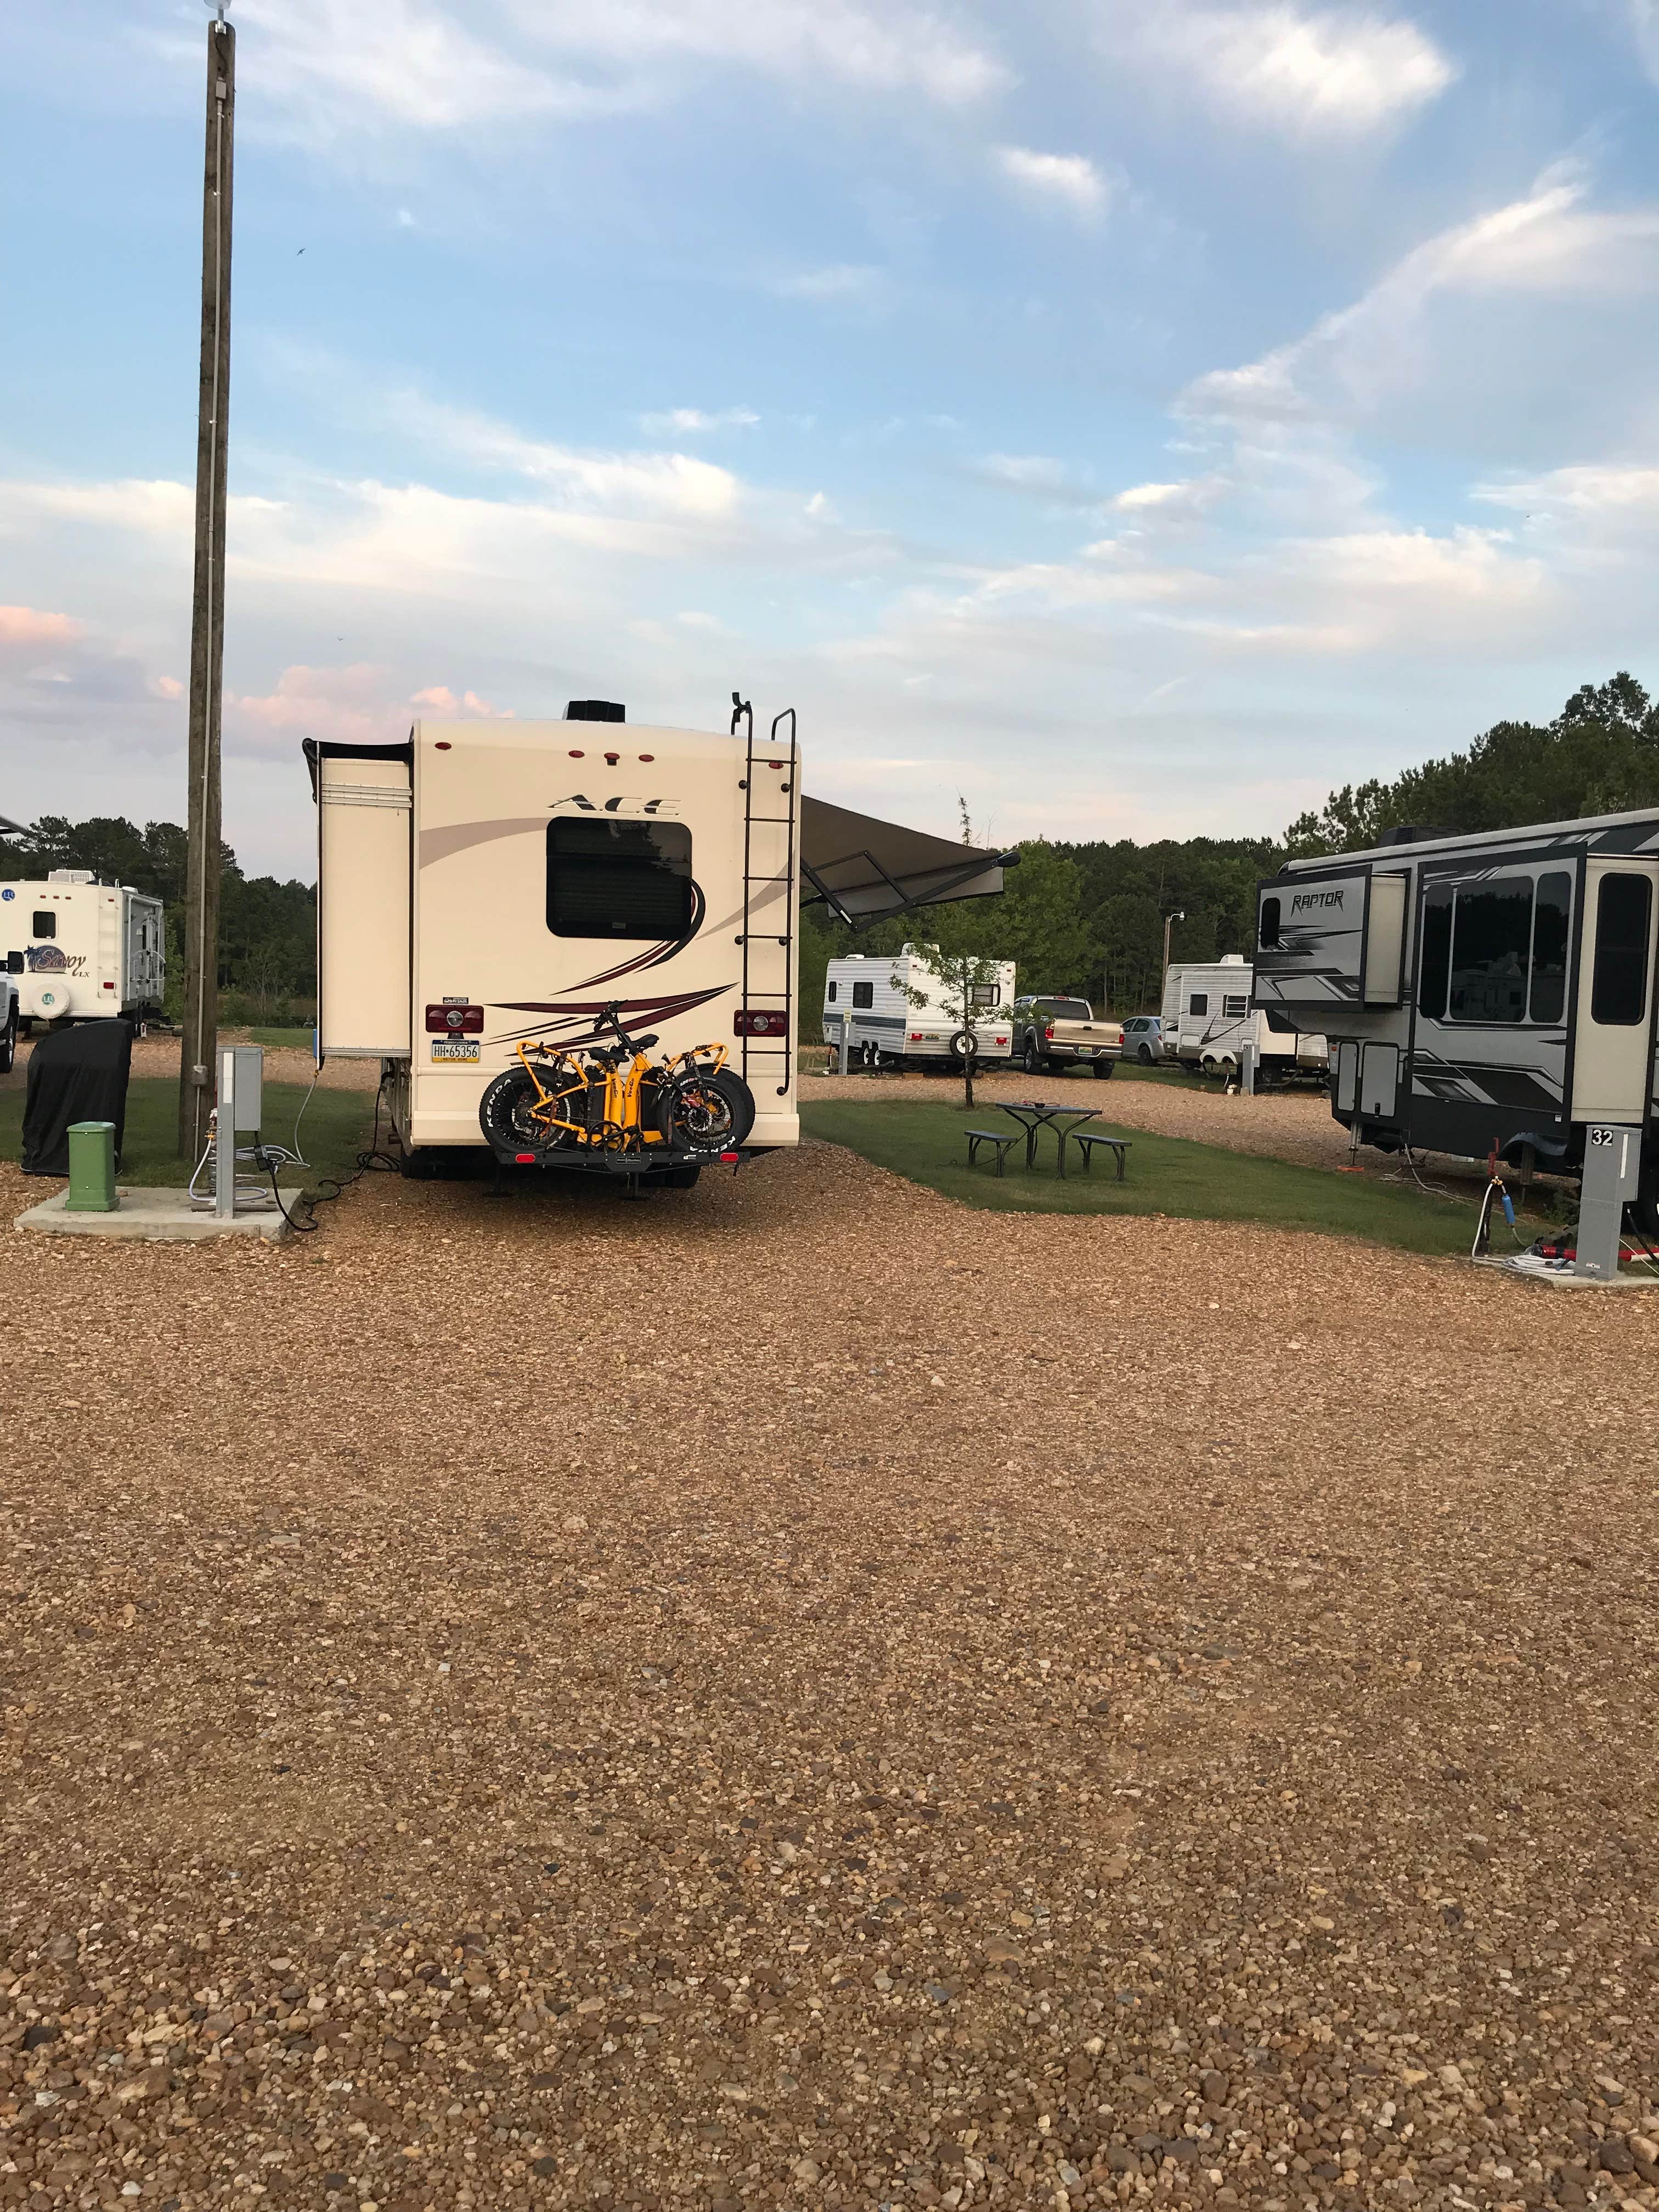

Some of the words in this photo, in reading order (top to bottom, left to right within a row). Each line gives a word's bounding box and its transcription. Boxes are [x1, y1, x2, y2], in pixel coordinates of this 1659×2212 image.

[1290, 890, 1344, 917] RAPTOR
[37, 949, 86, 977] Savoy
[487, 1079, 512, 1127] KENDA
[1592, 1129, 1613, 1147] 32
